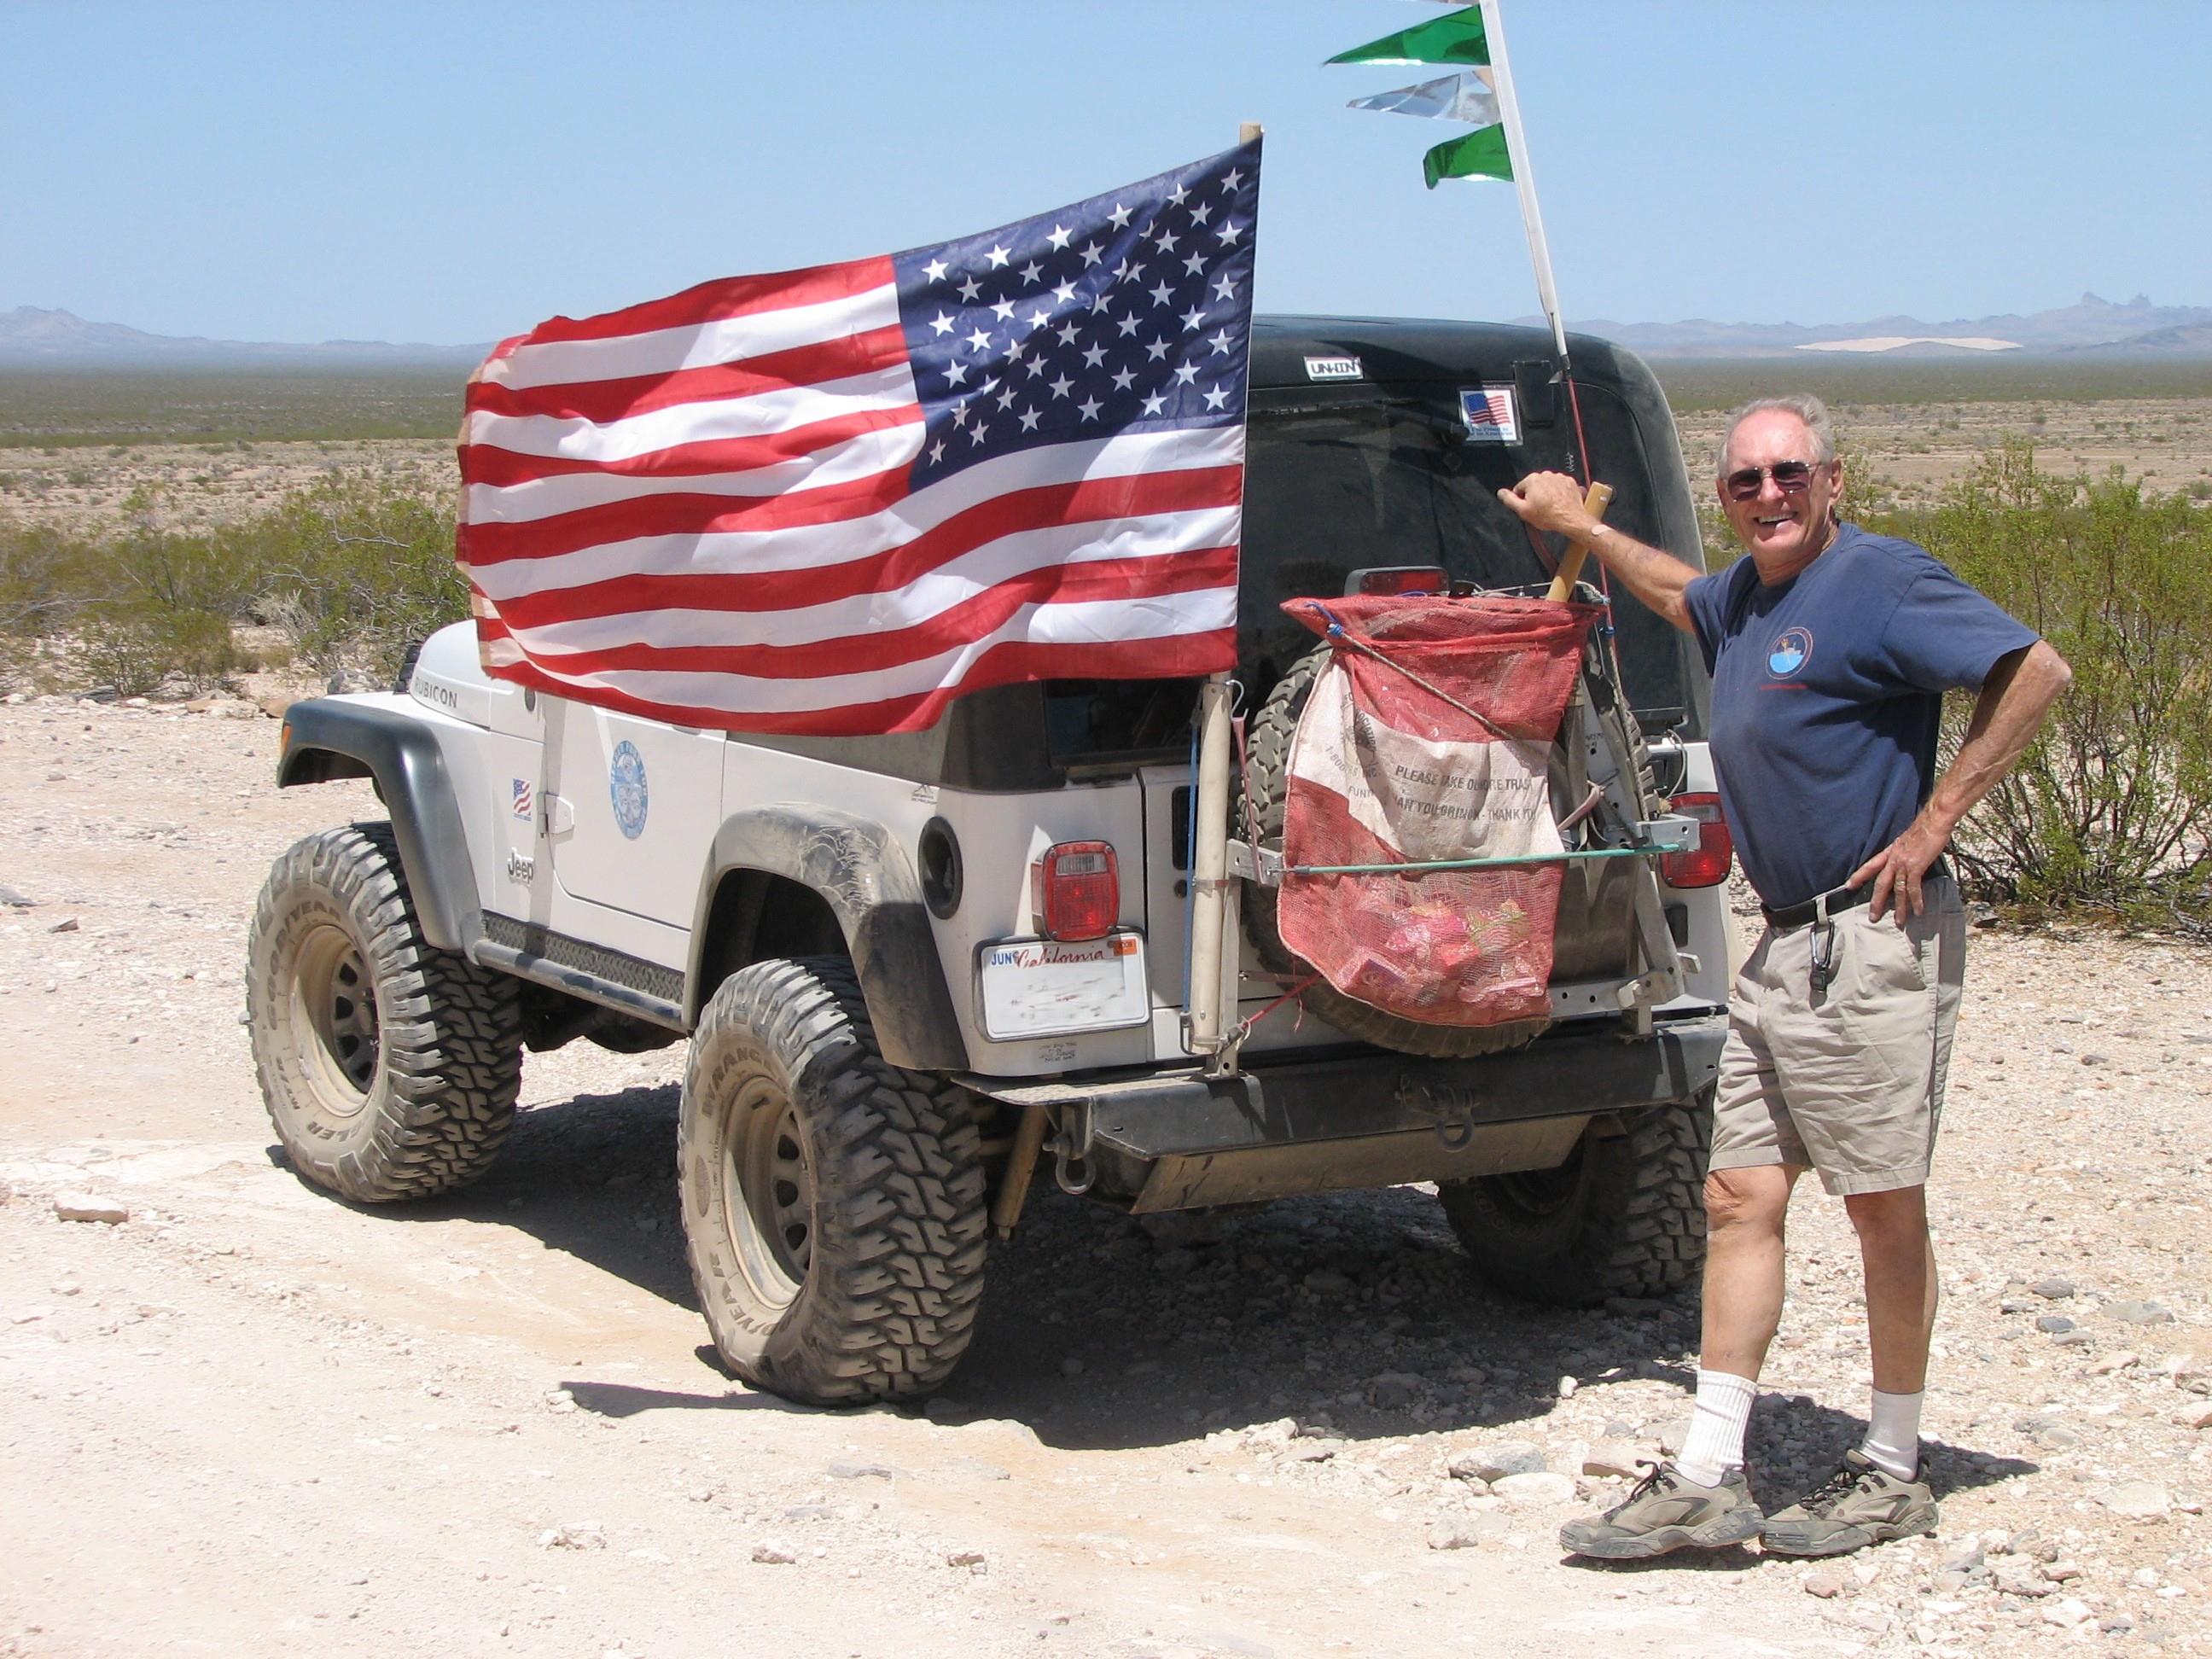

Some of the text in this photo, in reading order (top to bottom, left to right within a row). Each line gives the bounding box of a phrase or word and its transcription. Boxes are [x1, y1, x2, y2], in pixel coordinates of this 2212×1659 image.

[1395, 765, 1439, 785] PLEASE
[1487, 808, 1521, 821] THANK
[508, 850, 534, 885] Jeep
[991, 952, 1013, 966] JUN
